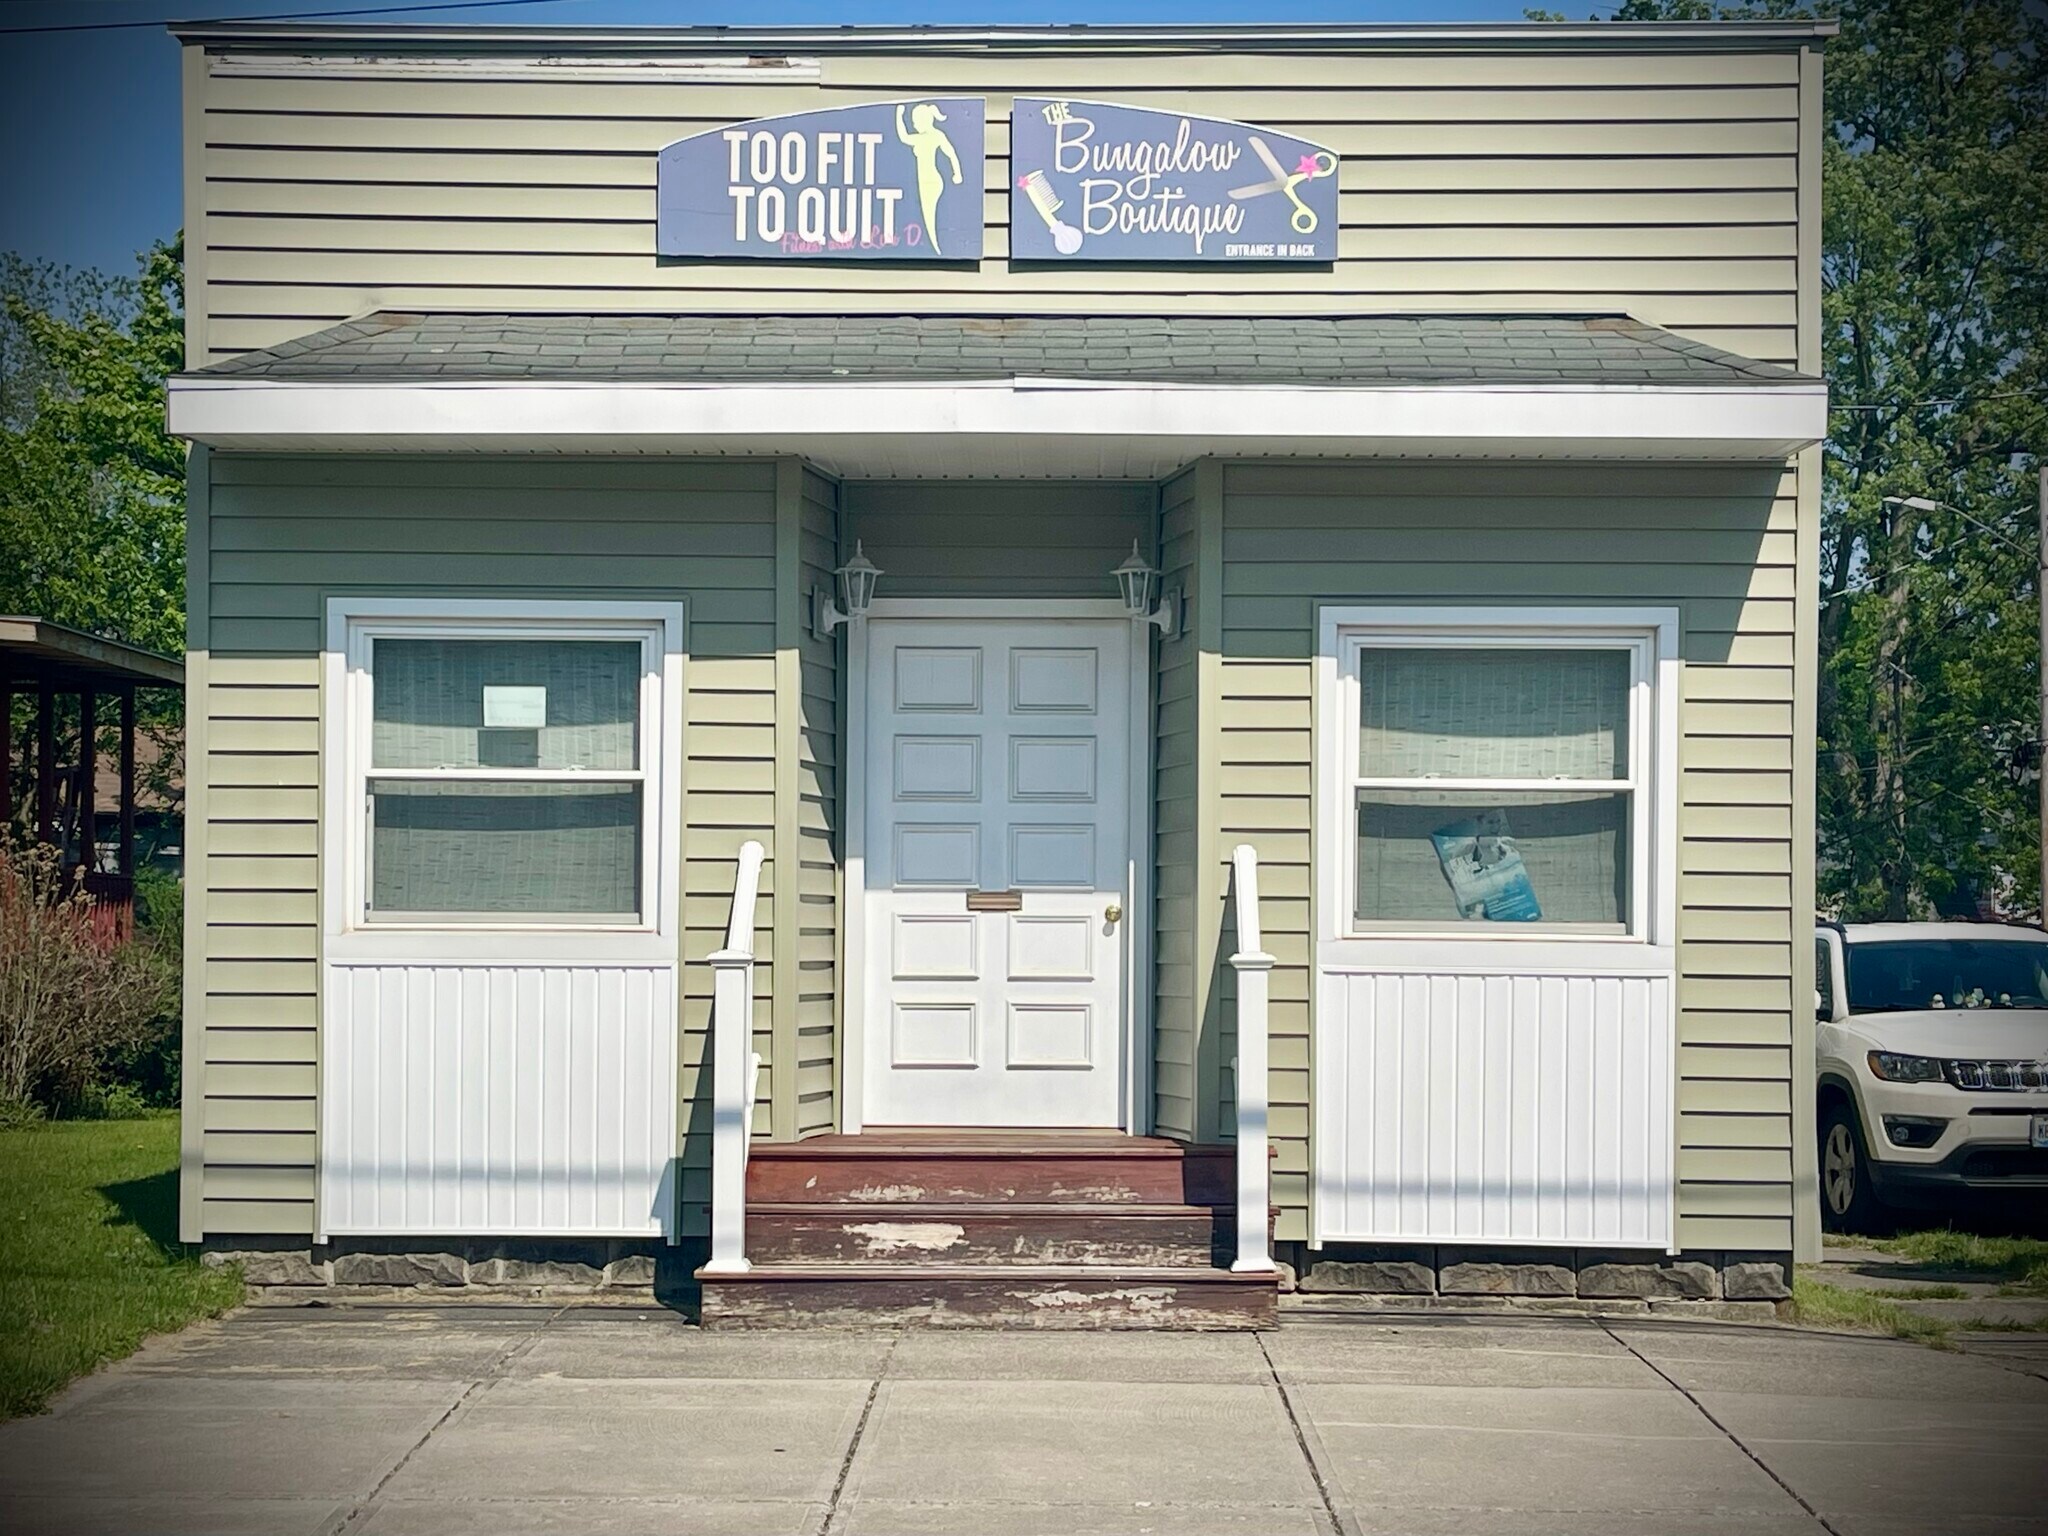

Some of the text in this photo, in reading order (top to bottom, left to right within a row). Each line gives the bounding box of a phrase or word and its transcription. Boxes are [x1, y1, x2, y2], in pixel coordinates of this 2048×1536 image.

[1041, 101, 1073, 125] THE
[723, 130, 883, 185] TOO FIT
[1050, 117, 1241, 200] Bungalow
[728, 186, 903, 245] TO QUIT
[1079, 178, 1245, 254] Boutique
[1225, 243, 1315, 257] ENTRANCE IN BACK
